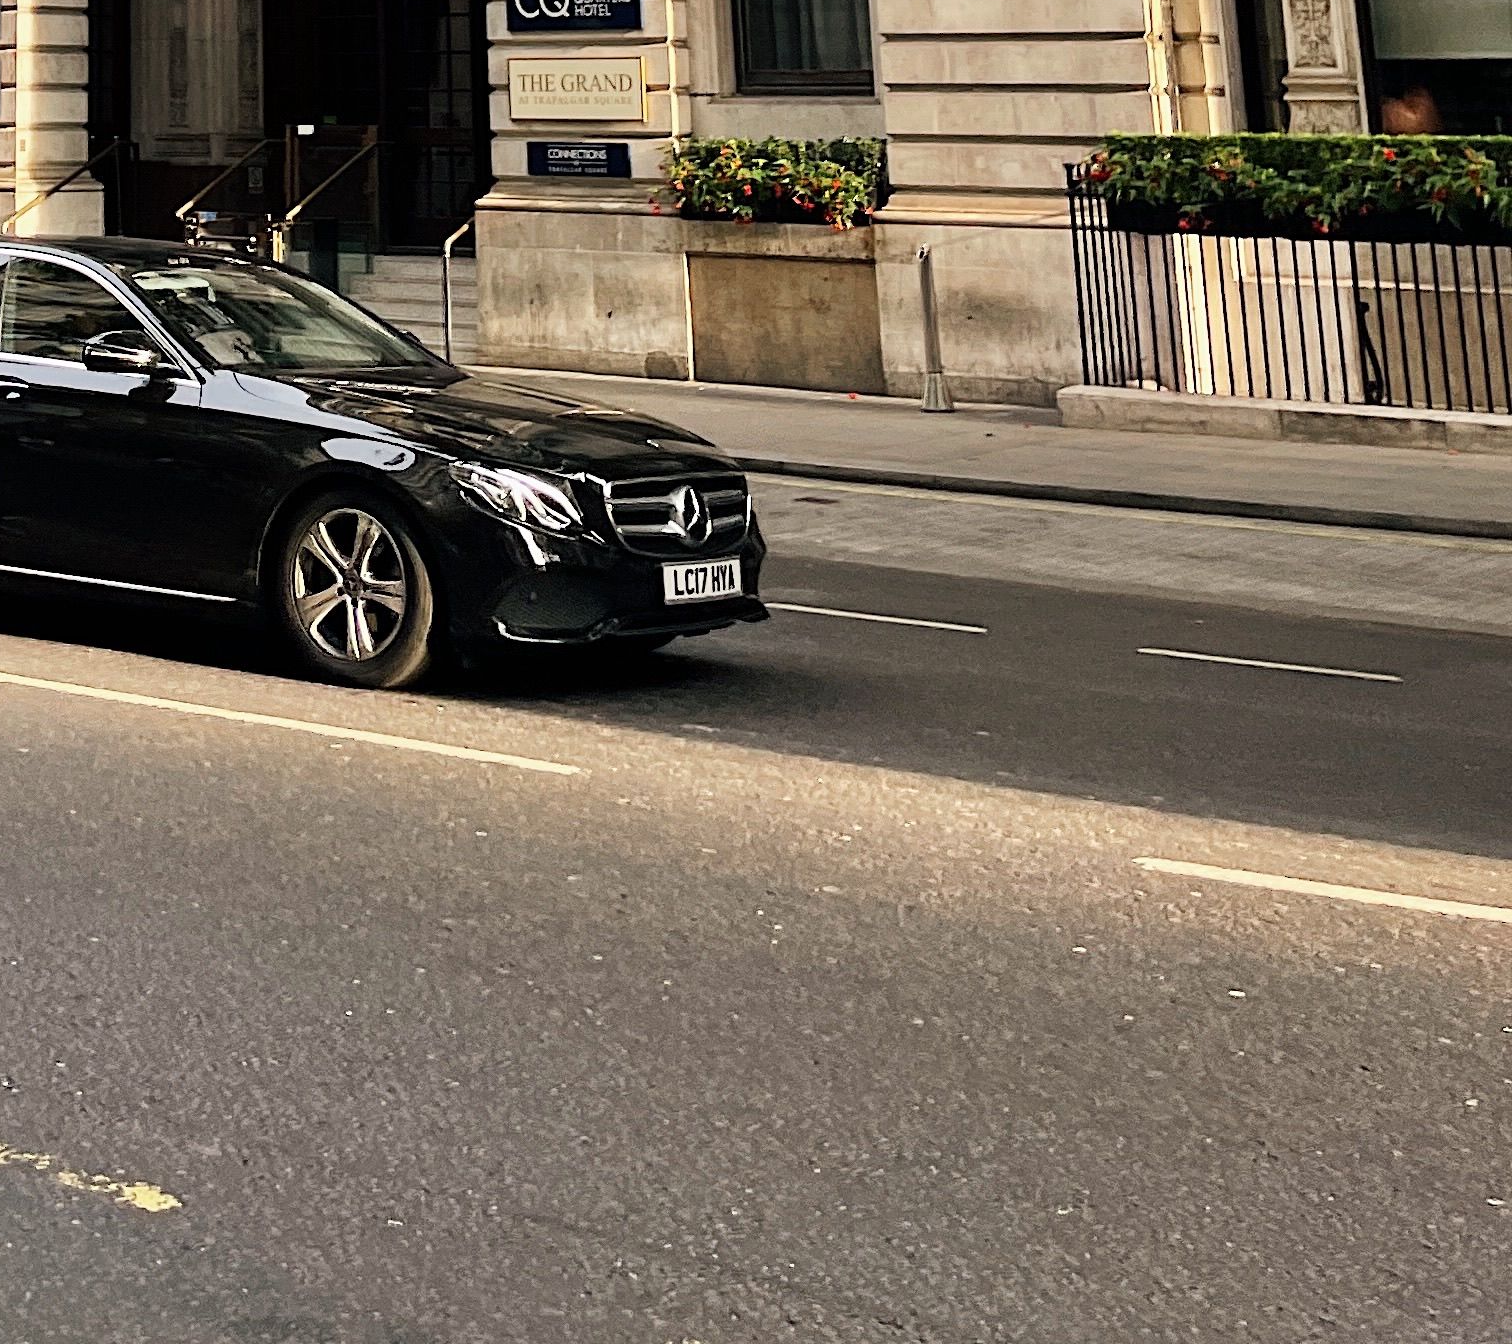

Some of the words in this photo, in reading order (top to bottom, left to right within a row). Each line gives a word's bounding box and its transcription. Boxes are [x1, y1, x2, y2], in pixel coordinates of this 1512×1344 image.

[574, 3, 611, 16] HOTEL
[517, 73, 556, 92] THE
[561, 73, 633, 92] GRAND
[519, 95, 529, 105] AT
[534, 95, 590, 105] TRAFALGAR
[593, 95, 632, 106] SQUARE
